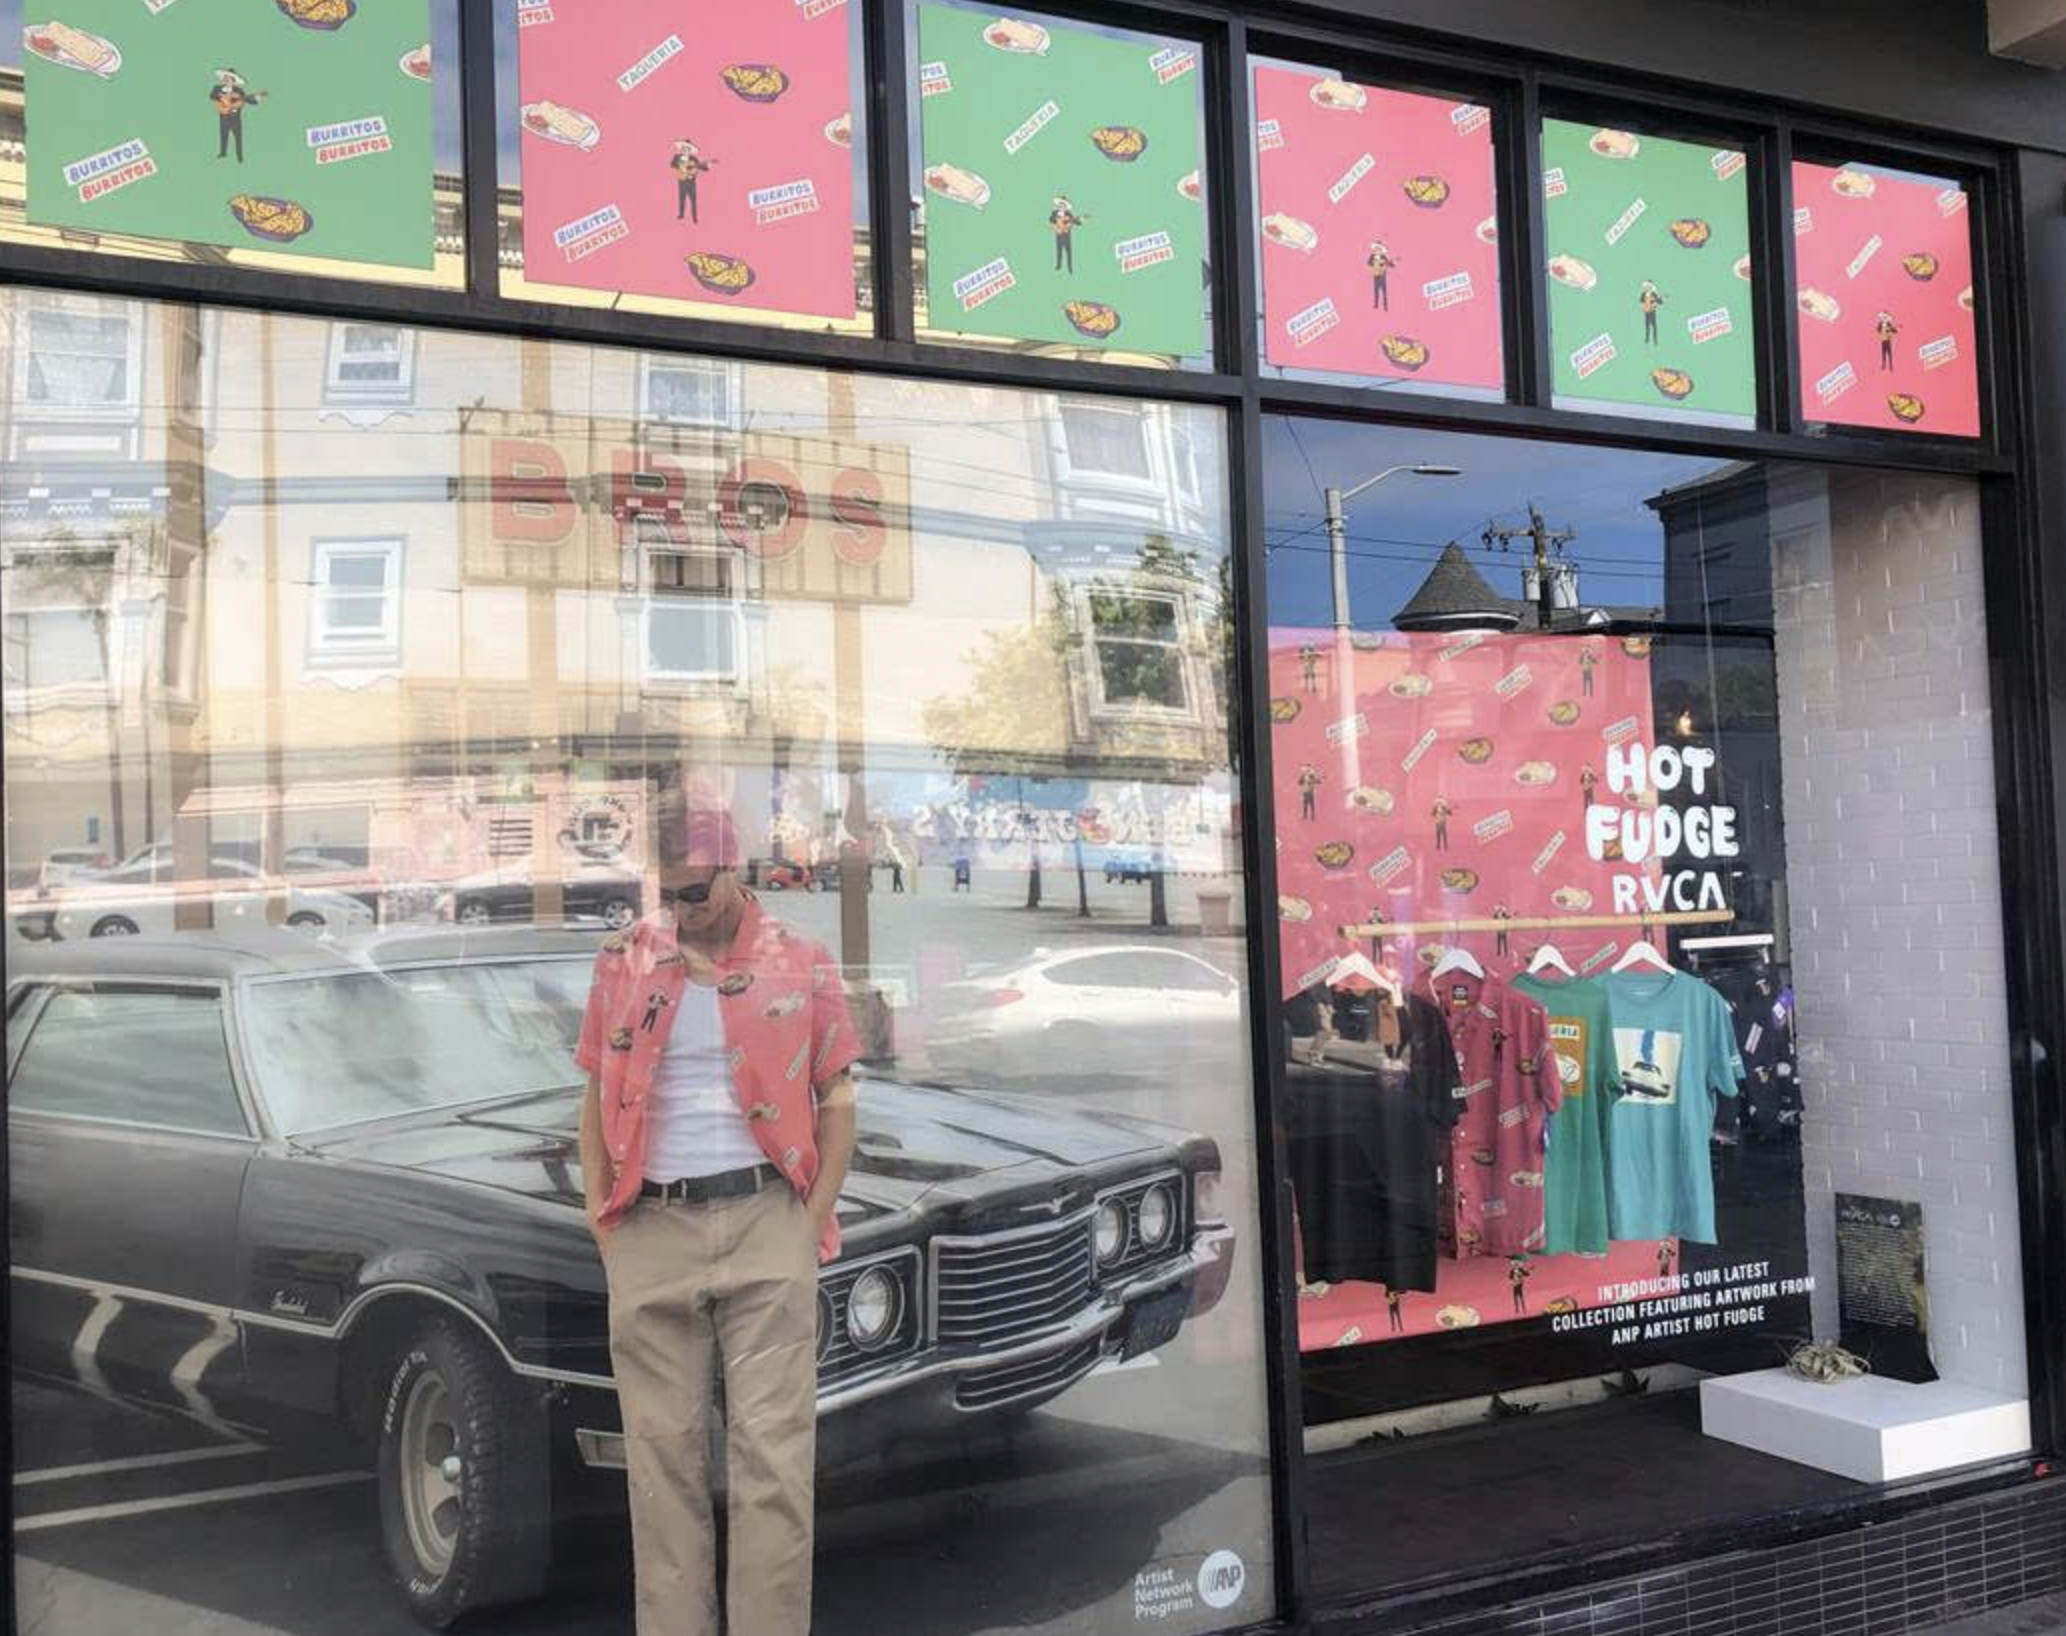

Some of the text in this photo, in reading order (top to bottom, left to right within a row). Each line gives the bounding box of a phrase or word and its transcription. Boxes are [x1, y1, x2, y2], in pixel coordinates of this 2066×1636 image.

[619, 39, 681, 86] TAQUERIA
[311, 119, 382, 144] BURRITOS
[319, 137, 389, 162] BURRITOS
[68, 141, 143, 183] BURRITOS
[81, 160, 154, 201] BURRITOS
[753, 182, 812, 205] BURRITOS
[759, 198, 816, 222] BURRITOS
[557, 207, 618, 245] BURRITOS
[567, 223, 626, 261] BURRITOS
[956, 260, 1006, 296] BURRITOS
[965, 275, 1013, 309] BURRITOS
[1606, 742, 1715, 795] HOT
[1586, 804, 1740, 864] FUDGE
[1598, 1261, 1770, 1301] INTRODUCING OUR LATEST
[1552, 1276, 1816, 1332] COLLECTION FEATURING ARTWORK FROM
[1611, 1305, 1766, 1346] ANP ARTIST HOT FUDGE
[1135, 1567, 1174, 1586] Artist
[1135, 1579, 1194, 1603] Network
[1135, 1597, 1194, 1620] Program
